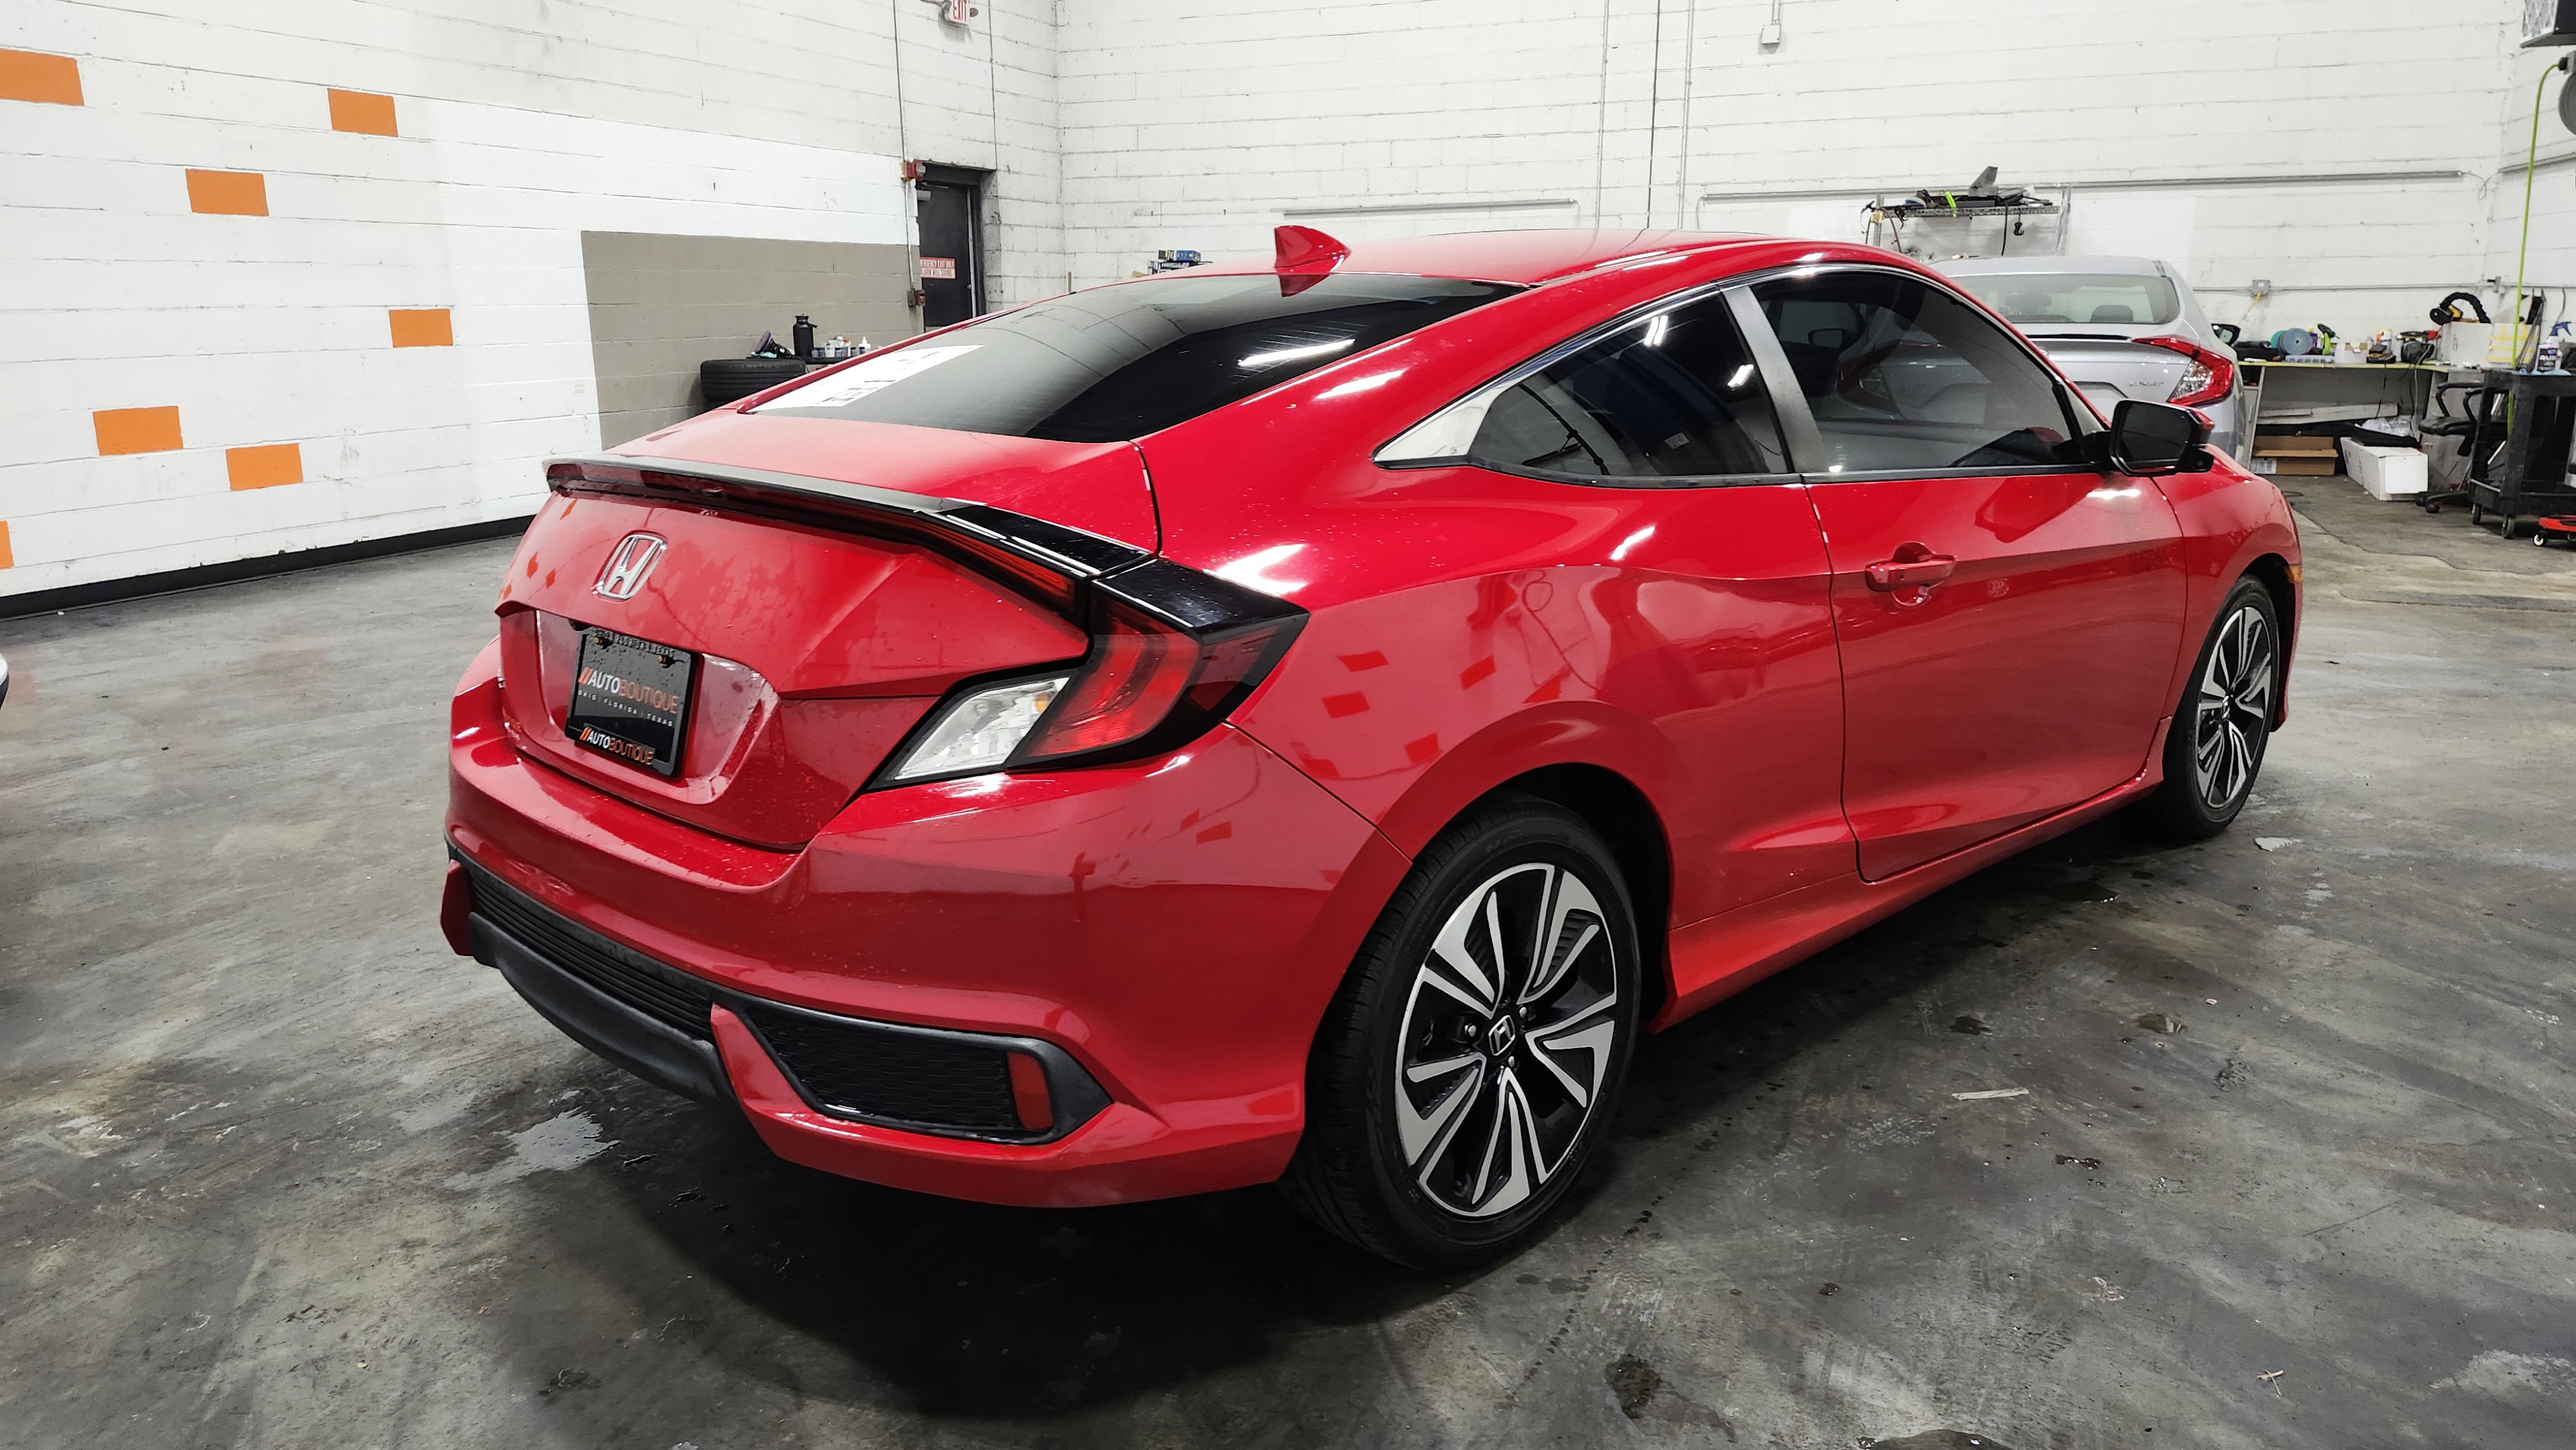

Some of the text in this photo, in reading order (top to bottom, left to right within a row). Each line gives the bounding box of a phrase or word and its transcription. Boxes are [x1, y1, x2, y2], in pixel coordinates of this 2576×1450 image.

[952, 0, 967, 23] EXIT
[603, 698, 637, 714] FLORIDA
[647, 713, 673, 727] TEXAS
